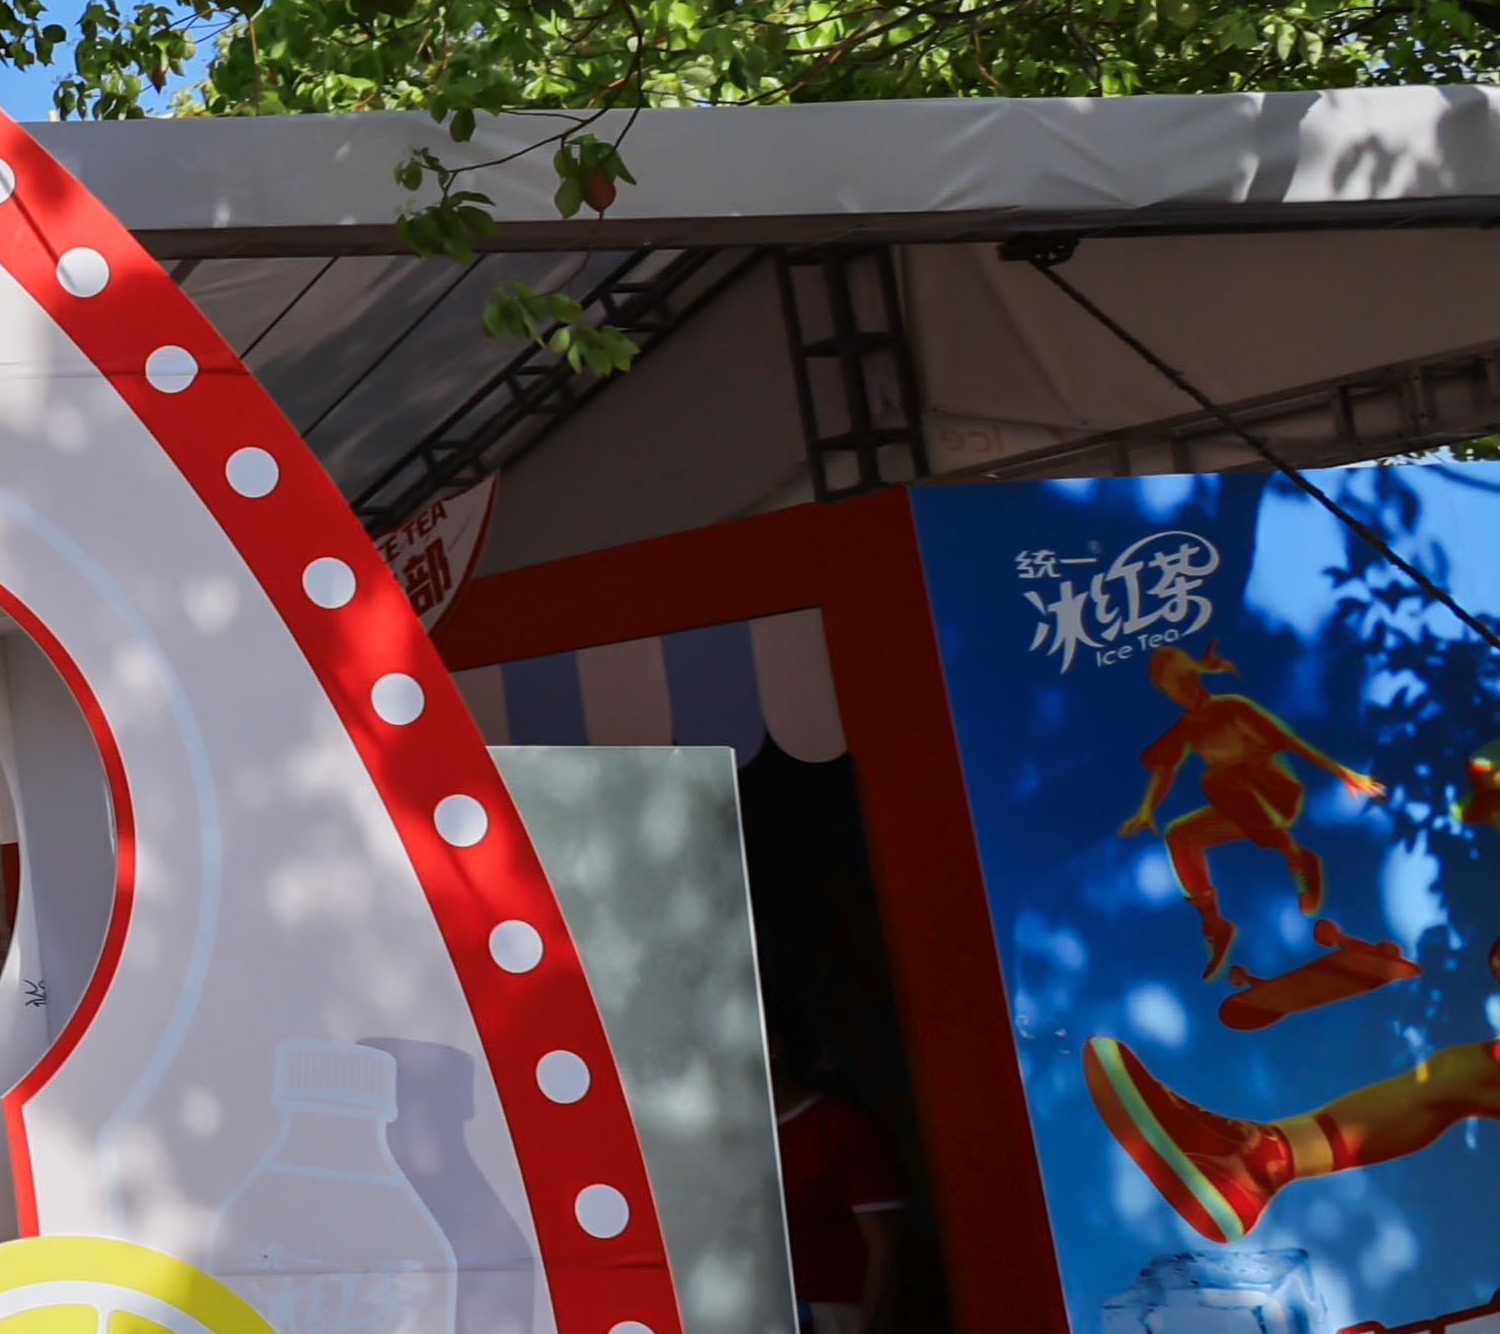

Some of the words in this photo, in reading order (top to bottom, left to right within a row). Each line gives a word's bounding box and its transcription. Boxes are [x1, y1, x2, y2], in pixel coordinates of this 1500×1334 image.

[1015, 548, 1098, 579] 统一
[1023, 530, 1220, 674] 冰红茶
[1095, 644, 1133, 667] Ice
[1136, 629, 1181, 651] Tea
